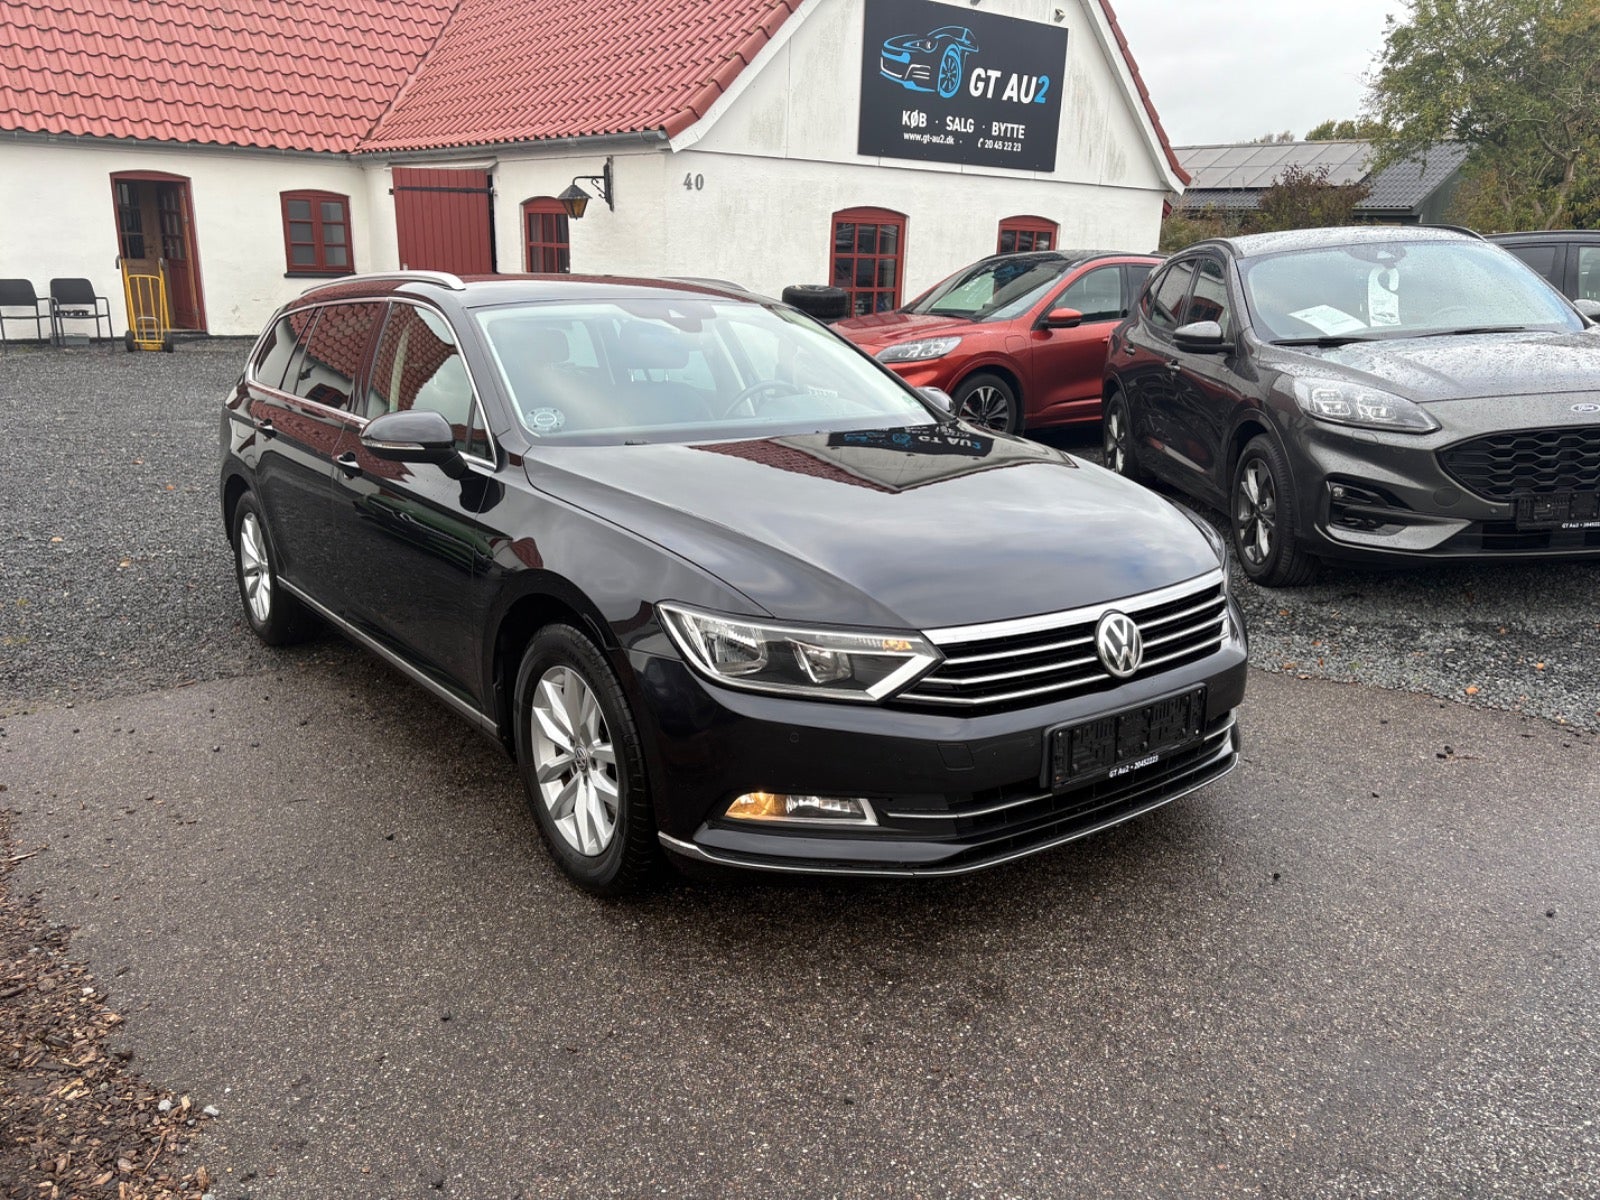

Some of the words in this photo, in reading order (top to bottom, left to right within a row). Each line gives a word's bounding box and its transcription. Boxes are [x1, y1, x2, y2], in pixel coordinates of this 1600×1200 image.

[969, 67, 1002, 99] GT
[1001, 73, 1050, 104] AU2
[902, 109, 928, 128] KØB
[945, 115, 975, 133] SALG
[991, 121, 1026, 139] BYTTE
[903, 132, 955, 145] www.gt-au2.dk
[984, 139, 993, 149] 20
[993, 140, 1003, 150] 45
[1003, 141, 1013, 151] 22
[1013, 142, 1022, 152] 23
[683, 172, 705, 191] 40
[1109, 769, 1118, 778] GT
